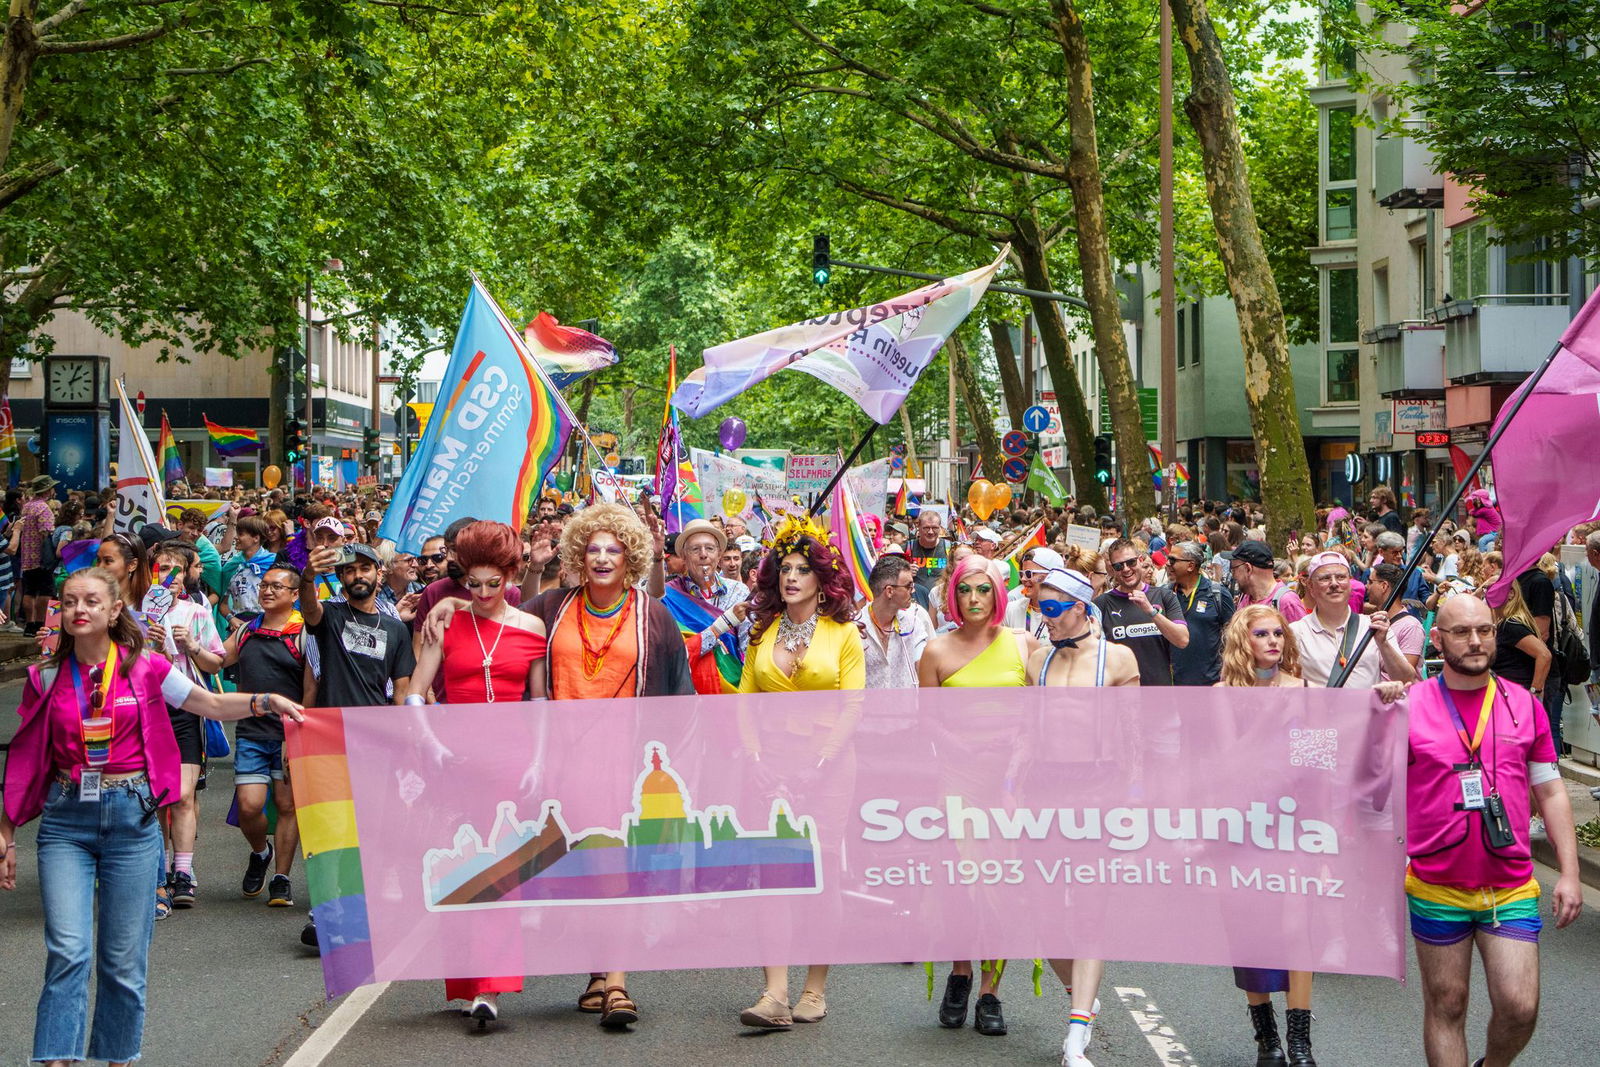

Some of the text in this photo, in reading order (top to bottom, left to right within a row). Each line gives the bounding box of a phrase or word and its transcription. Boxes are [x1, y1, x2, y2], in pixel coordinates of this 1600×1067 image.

[1417, 434, 1449, 443] OPEN
[792, 457, 815, 466] FREE
[317, 518, 339, 527] GAY
[1130, 624, 1160, 634] congsto
[860, 796, 1338, 855] Schwuguntia
[865, 857, 1344, 898] seit 1993 Vielfalt in Mainz
